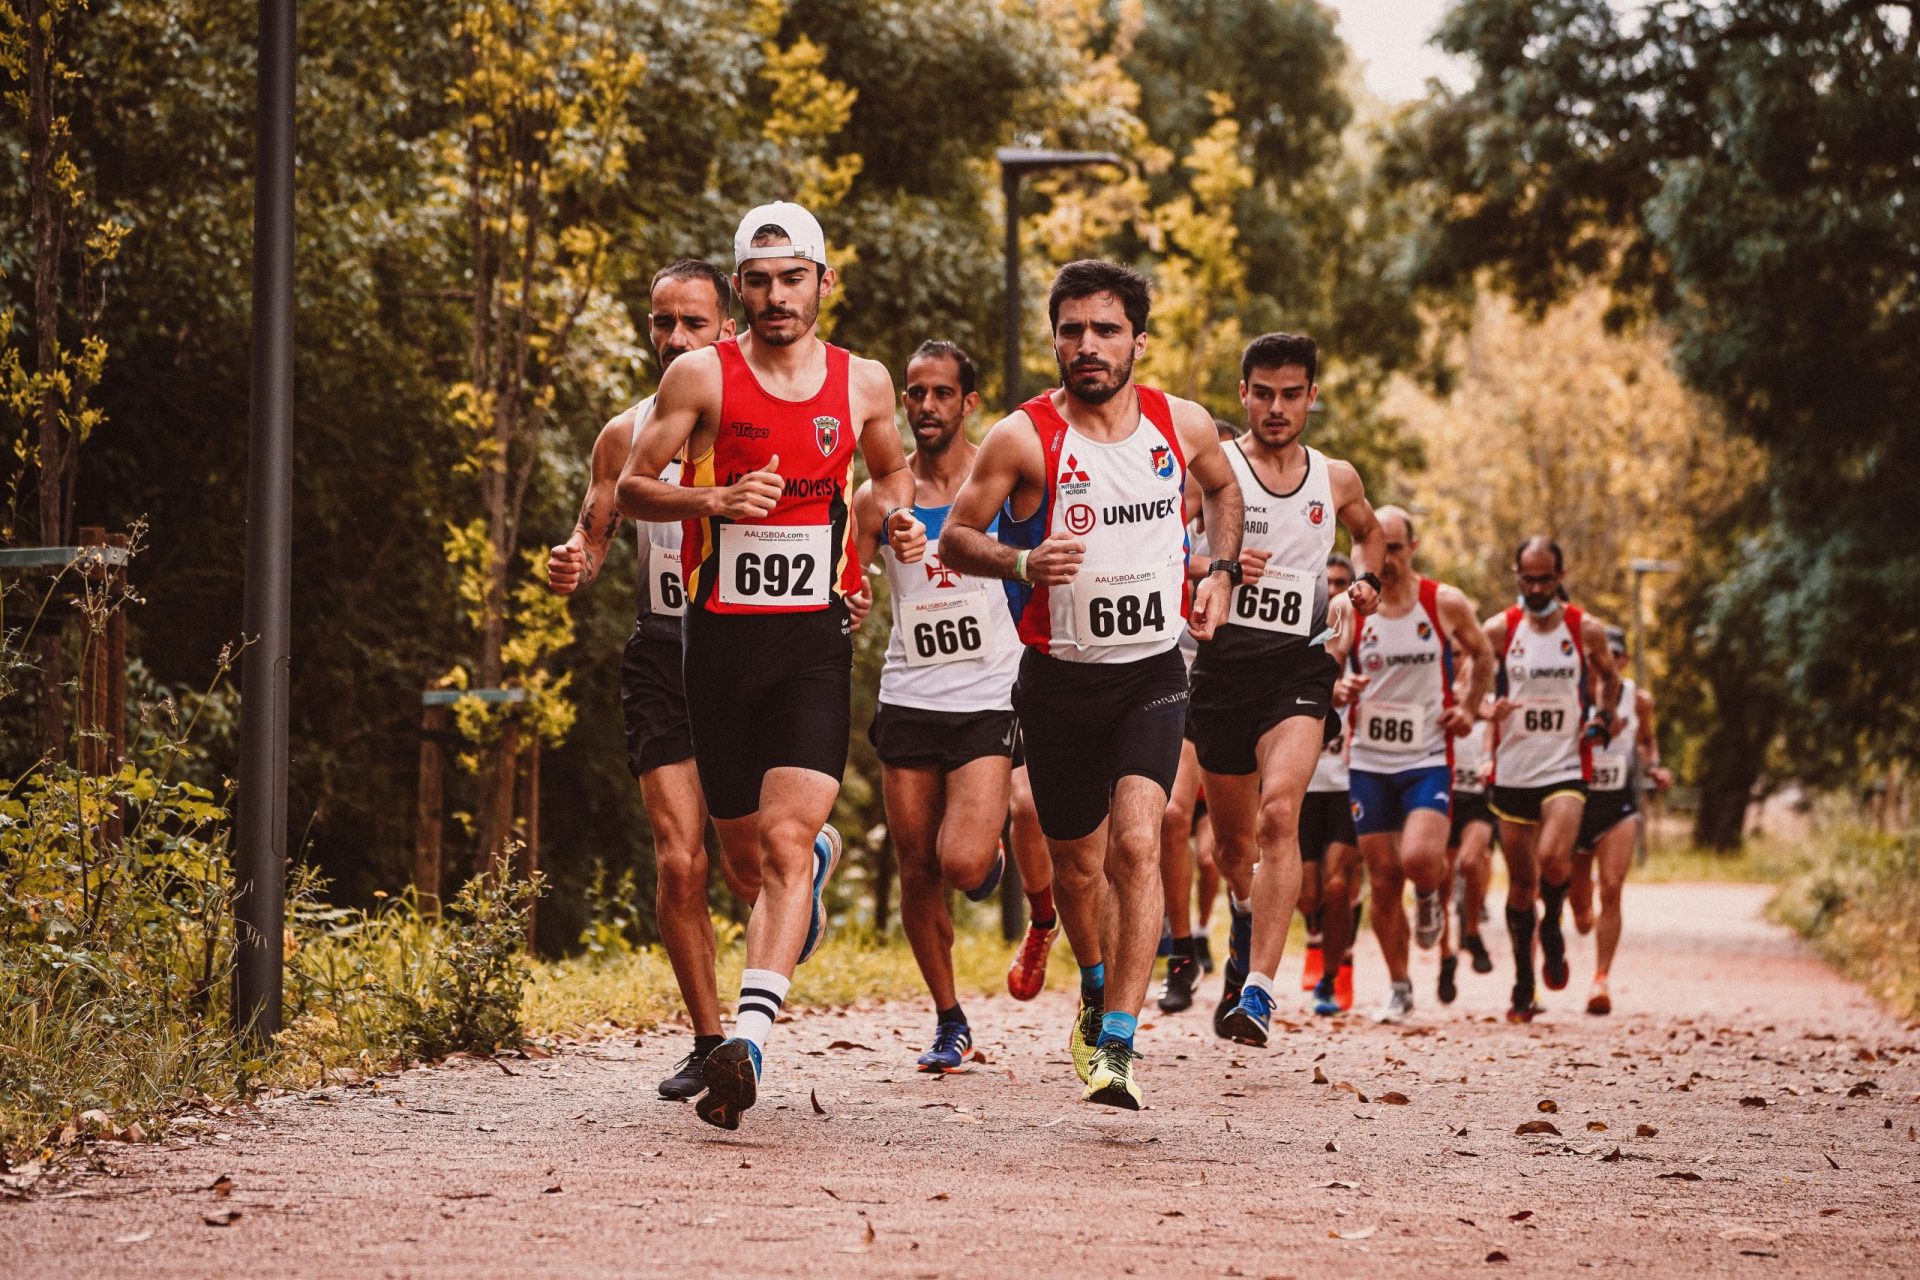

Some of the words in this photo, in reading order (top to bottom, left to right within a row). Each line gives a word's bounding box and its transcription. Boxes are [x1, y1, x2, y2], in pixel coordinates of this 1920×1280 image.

[1060, 482, 1091, 490] MITSUBISHI
[1065, 488, 1088, 496] MOTORS
[1103, 496, 1176, 526] UNIVEX
[744, 530, 804, 539] AALISBOA.com
[735, 552, 815, 597] 692
[1095, 572, 1151, 584] AALISBOA.com
[915, 600, 963, 611] AALISBOA.com
[1089, 590, 1166, 638] 684
[1236, 583, 1302, 626] 658
[914, 616, 982, 658] 666
[1386, 653, 1436, 667] UNIVEX
[1369, 715, 1414, 743] 686
[1525, 709, 1565, 732] 687
